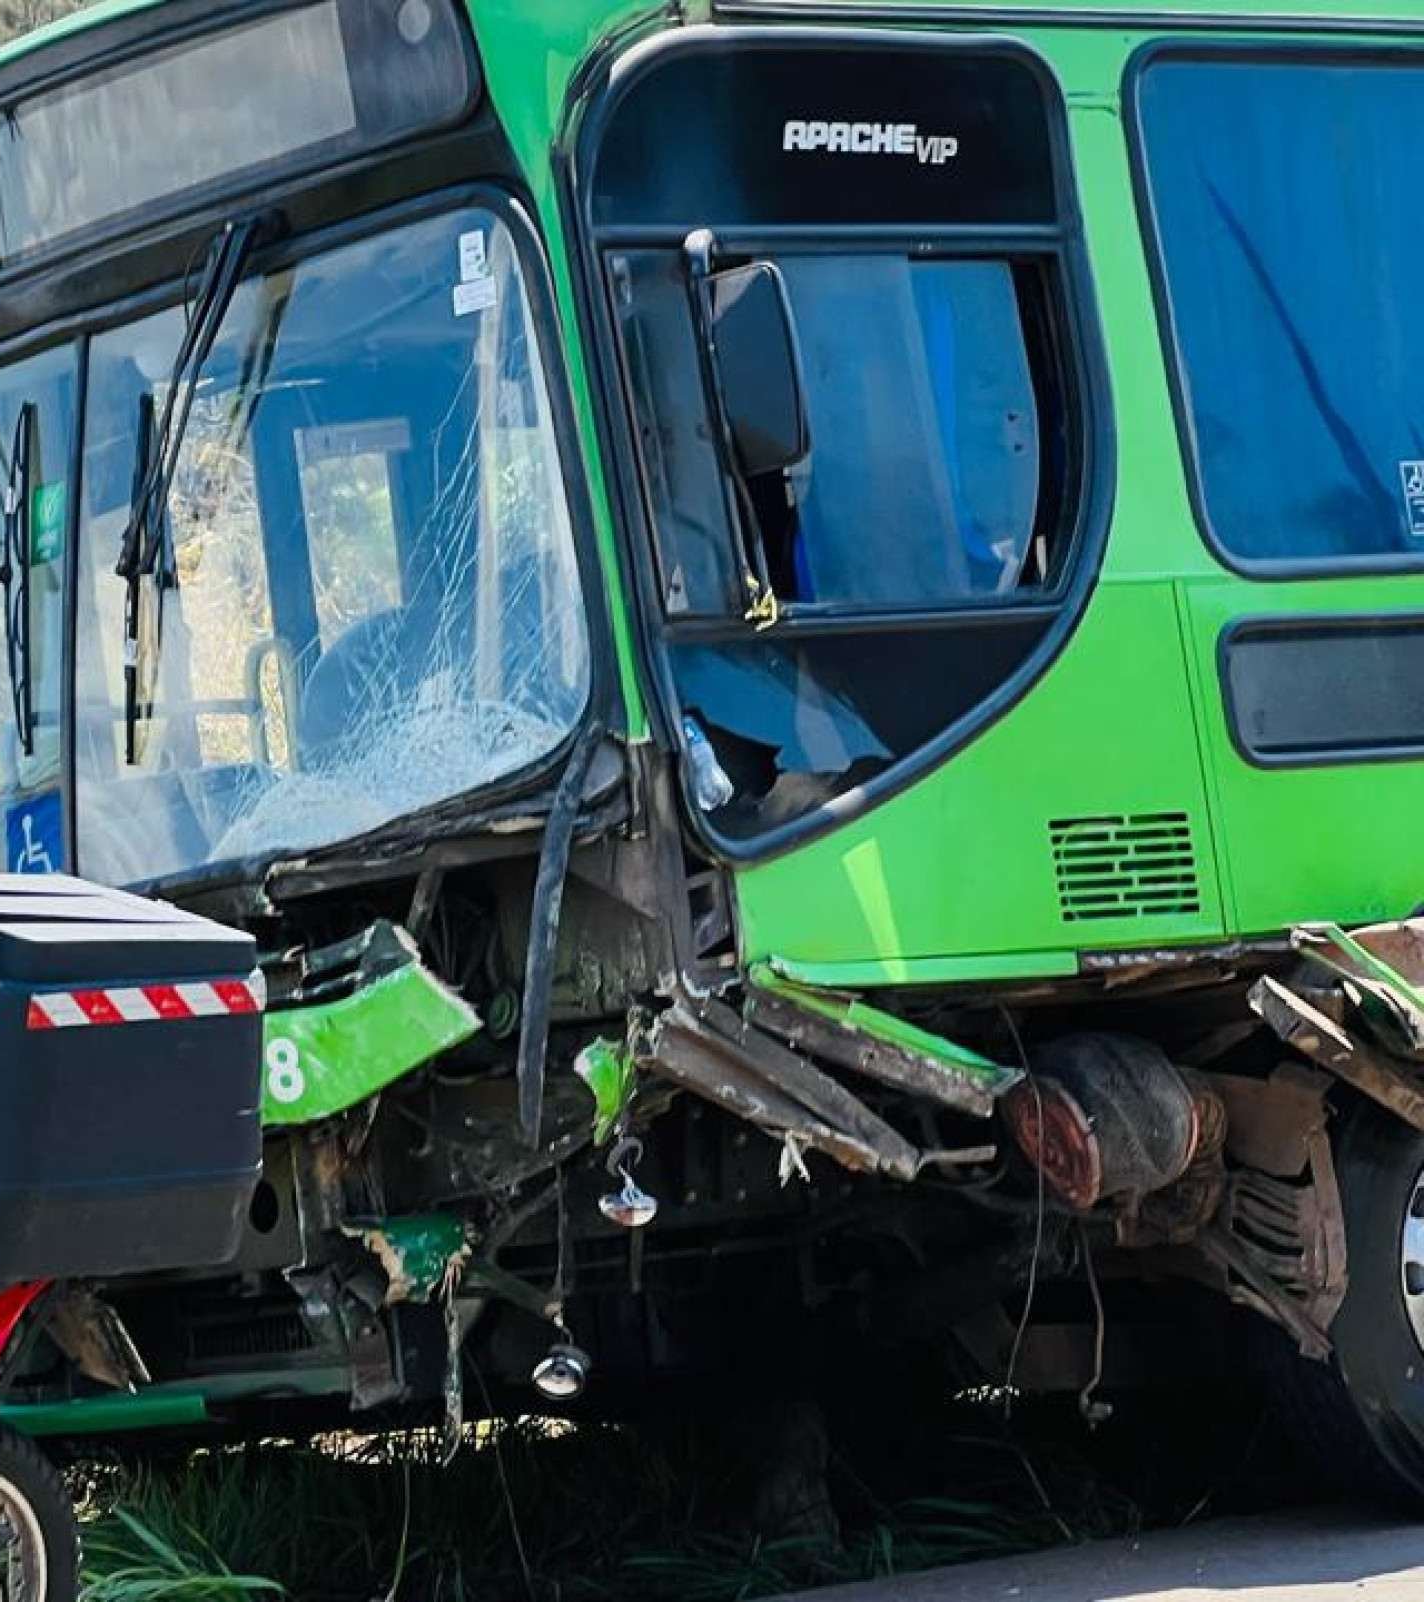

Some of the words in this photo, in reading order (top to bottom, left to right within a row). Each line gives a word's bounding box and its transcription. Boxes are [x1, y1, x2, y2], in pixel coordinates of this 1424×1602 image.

[783, 120, 916, 153] APACHE
[916, 136, 958, 163] VIP
[266, 1037, 305, 1104] 8
